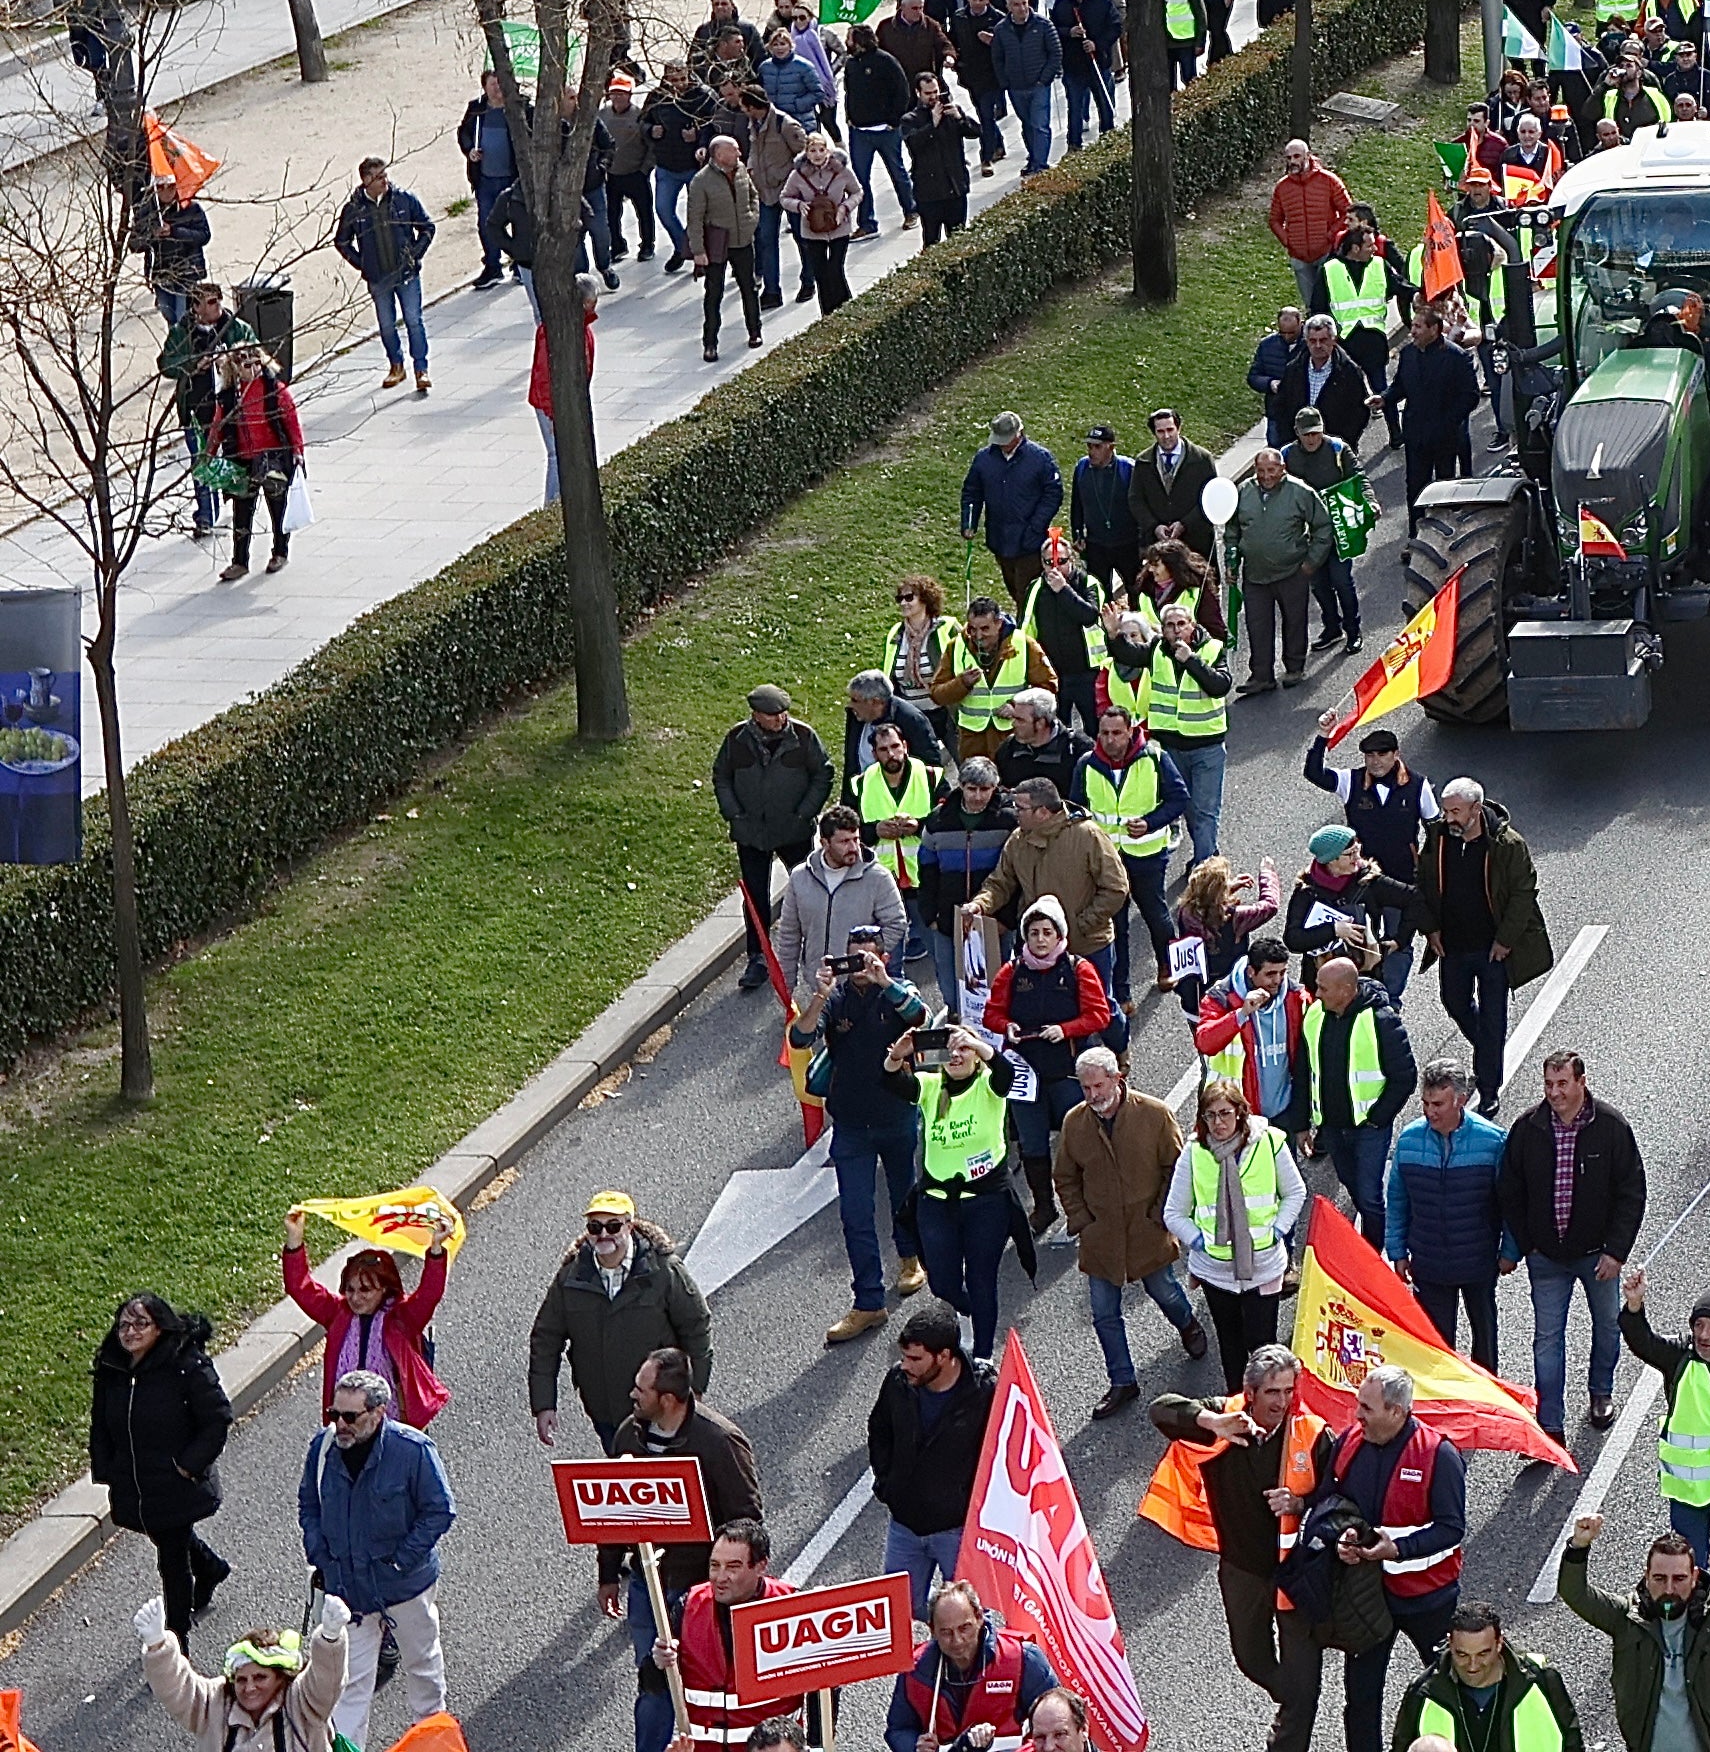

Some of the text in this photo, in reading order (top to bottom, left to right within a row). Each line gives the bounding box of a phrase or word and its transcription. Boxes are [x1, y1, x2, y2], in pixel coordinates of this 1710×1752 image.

[577, 1481, 685, 1506] UAGN
[759, 1602, 887, 1654] UAGN
[1022, 1598, 1072, 1680] GANADEROS
[1070, 1677, 1083, 1697] DE
